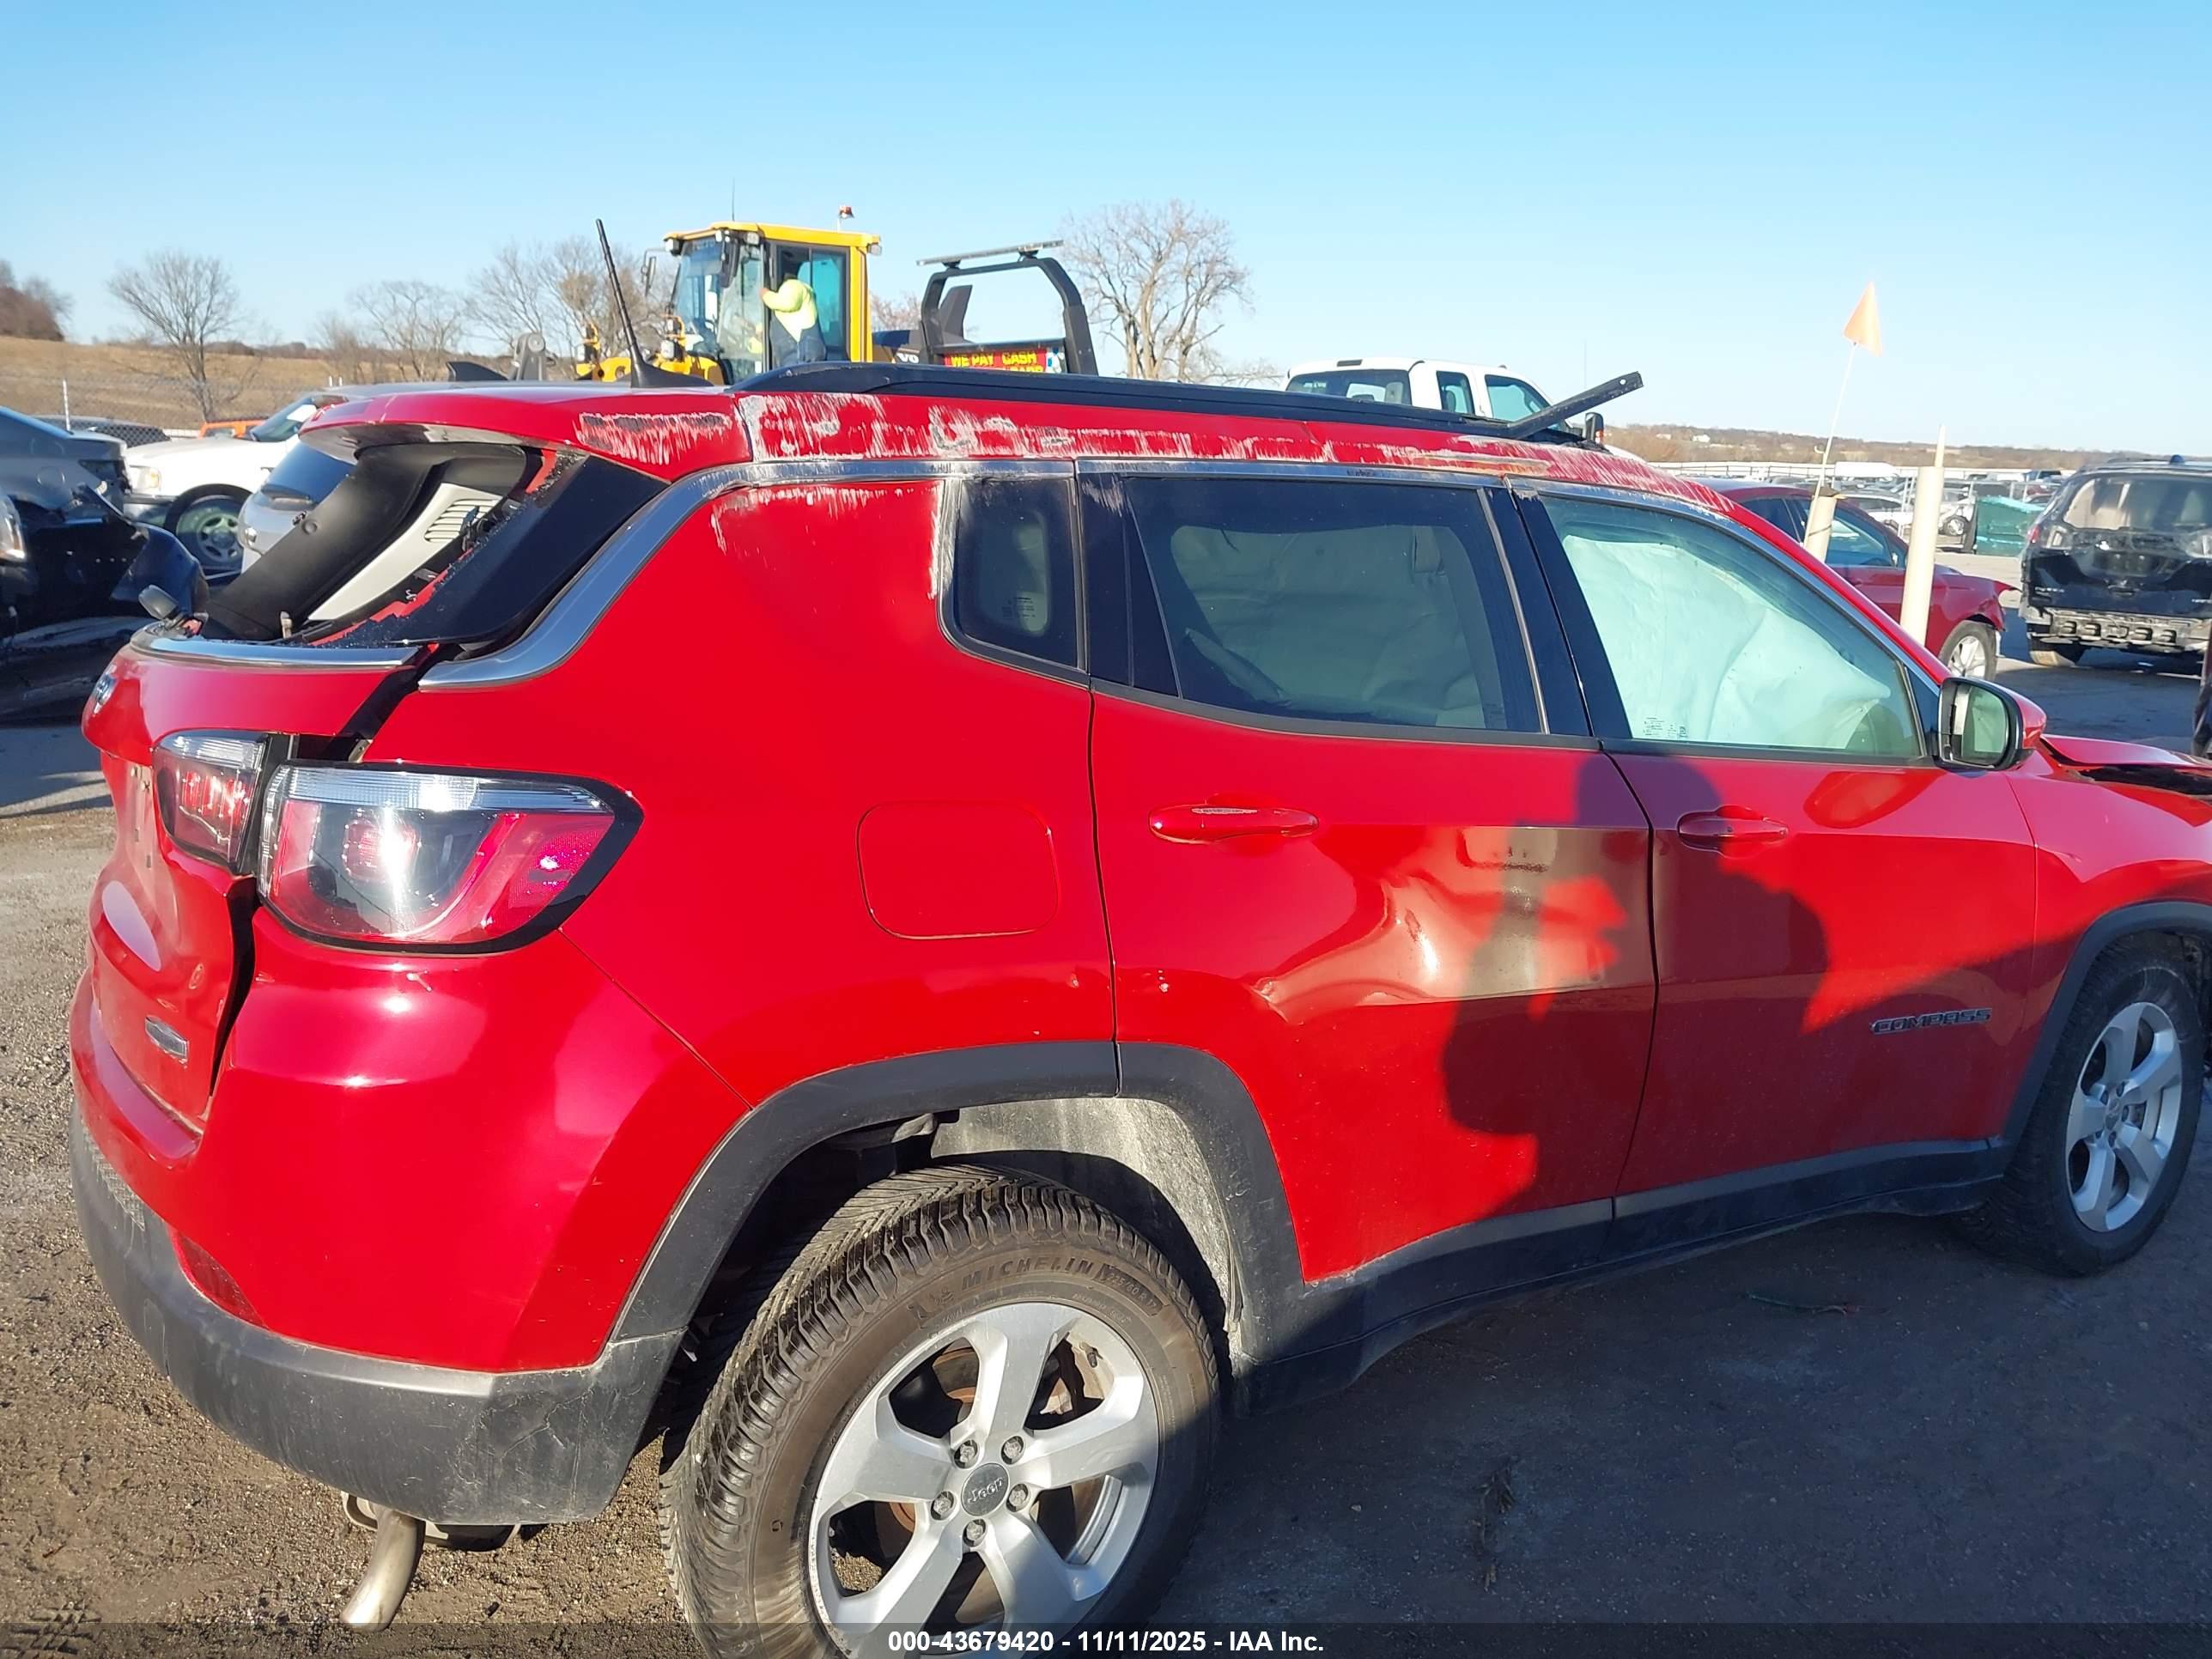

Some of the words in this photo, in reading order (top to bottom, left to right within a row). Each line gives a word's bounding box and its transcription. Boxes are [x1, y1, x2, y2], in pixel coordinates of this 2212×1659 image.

[951, 355, 969, 368] WE
[971, 353, 994, 367] PAY
[1001, 350, 1037, 365] CASH
[1870, 1007, 1993, 1036] COMPASS
[962, 1256, 1095, 1290] MICHELIN
[967, 1476, 1004, 1504] Jeep
